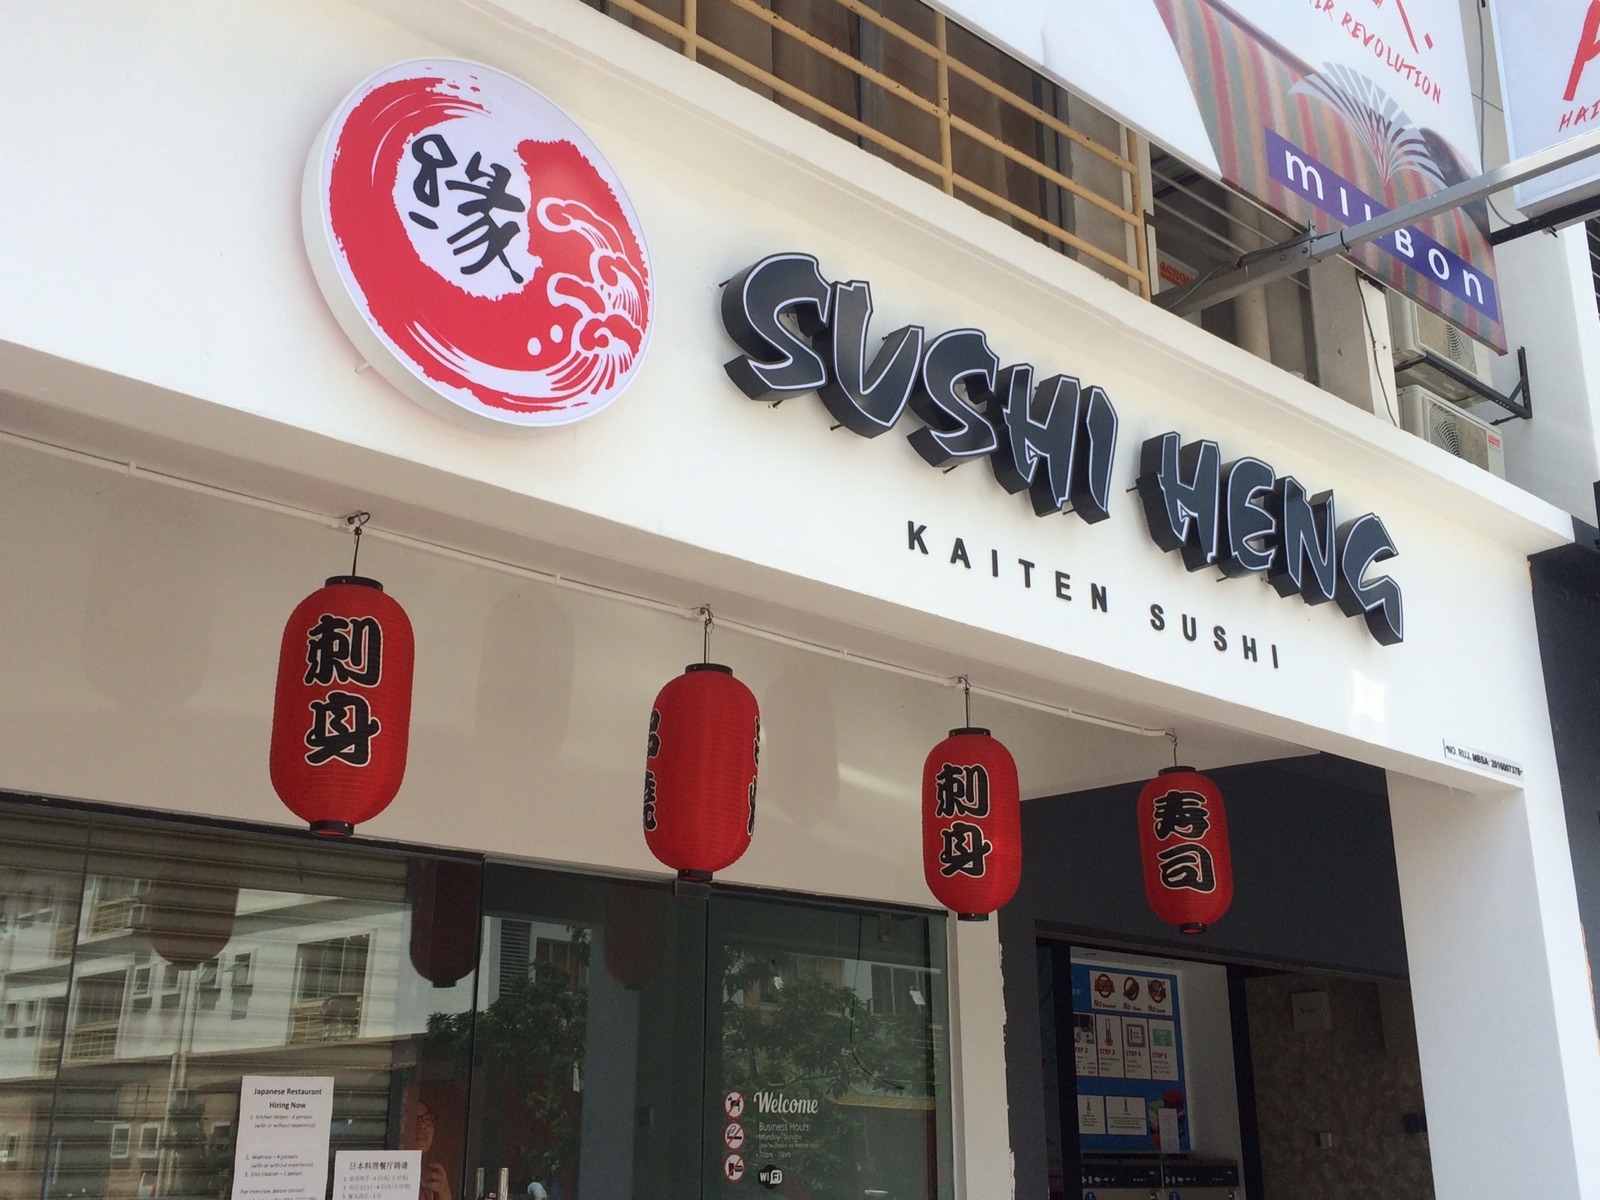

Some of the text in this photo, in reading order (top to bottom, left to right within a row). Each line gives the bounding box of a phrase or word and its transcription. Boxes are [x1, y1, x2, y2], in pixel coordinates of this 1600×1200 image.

[1341, 12, 1441, 104] REVOLUTION
[722, 252, 1403, 645] SUSHI HENG
[908, 520, 1279, 669] KAITEN SUSHI
[303, 613, 383, 767] 刺身
[1472, 753, 1489, 766] MBSA
[935, 762, 993, 879] 刺身
[254, 1088, 285, 1096] Japanese
[753, 1092, 819, 1113] Welcome
[759, 1122, 788, 1131] Business
